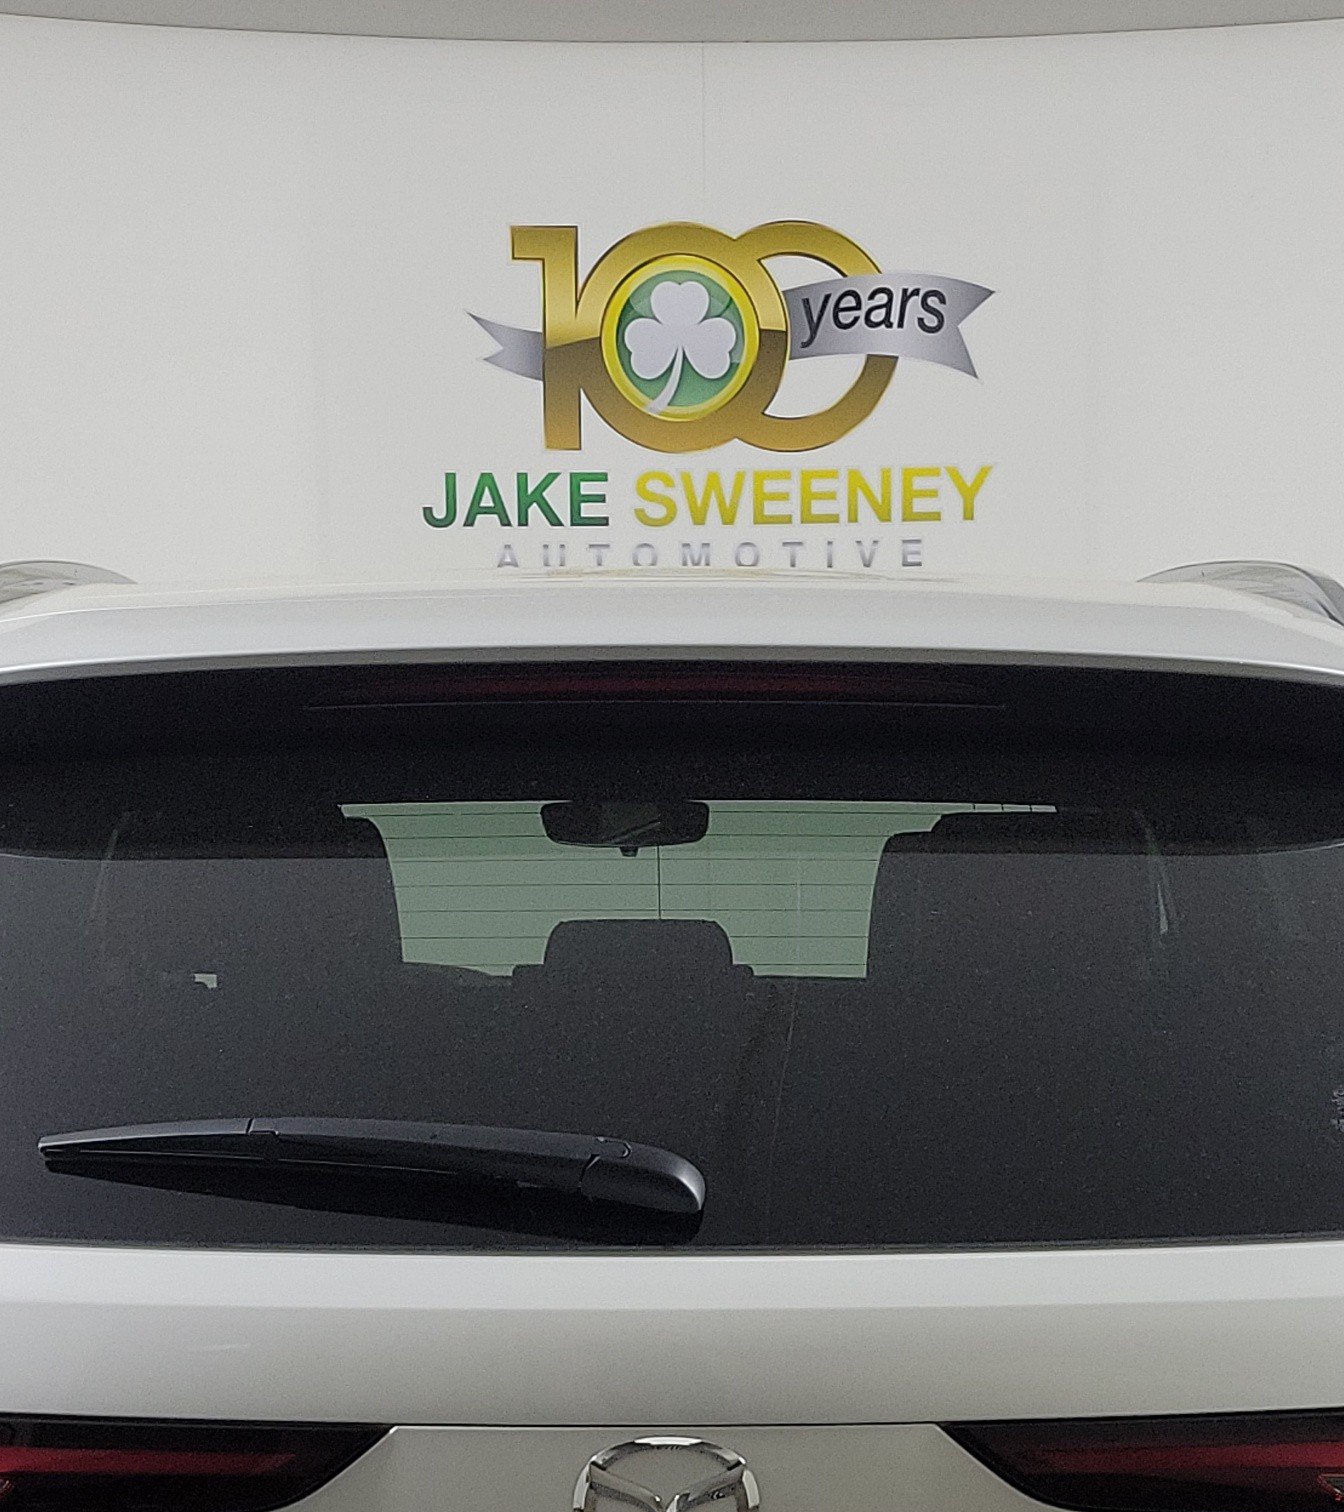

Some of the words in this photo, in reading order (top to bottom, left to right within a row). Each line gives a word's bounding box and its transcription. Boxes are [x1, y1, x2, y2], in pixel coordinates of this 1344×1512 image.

[510, 220, 899, 452] 100
[800, 283, 946, 348] years
[422, 471, 609, 528] JAKE
[634, 465, 993, 527] SWEENEY
[496, 538, 923, 568] AUTOMOTIVE
